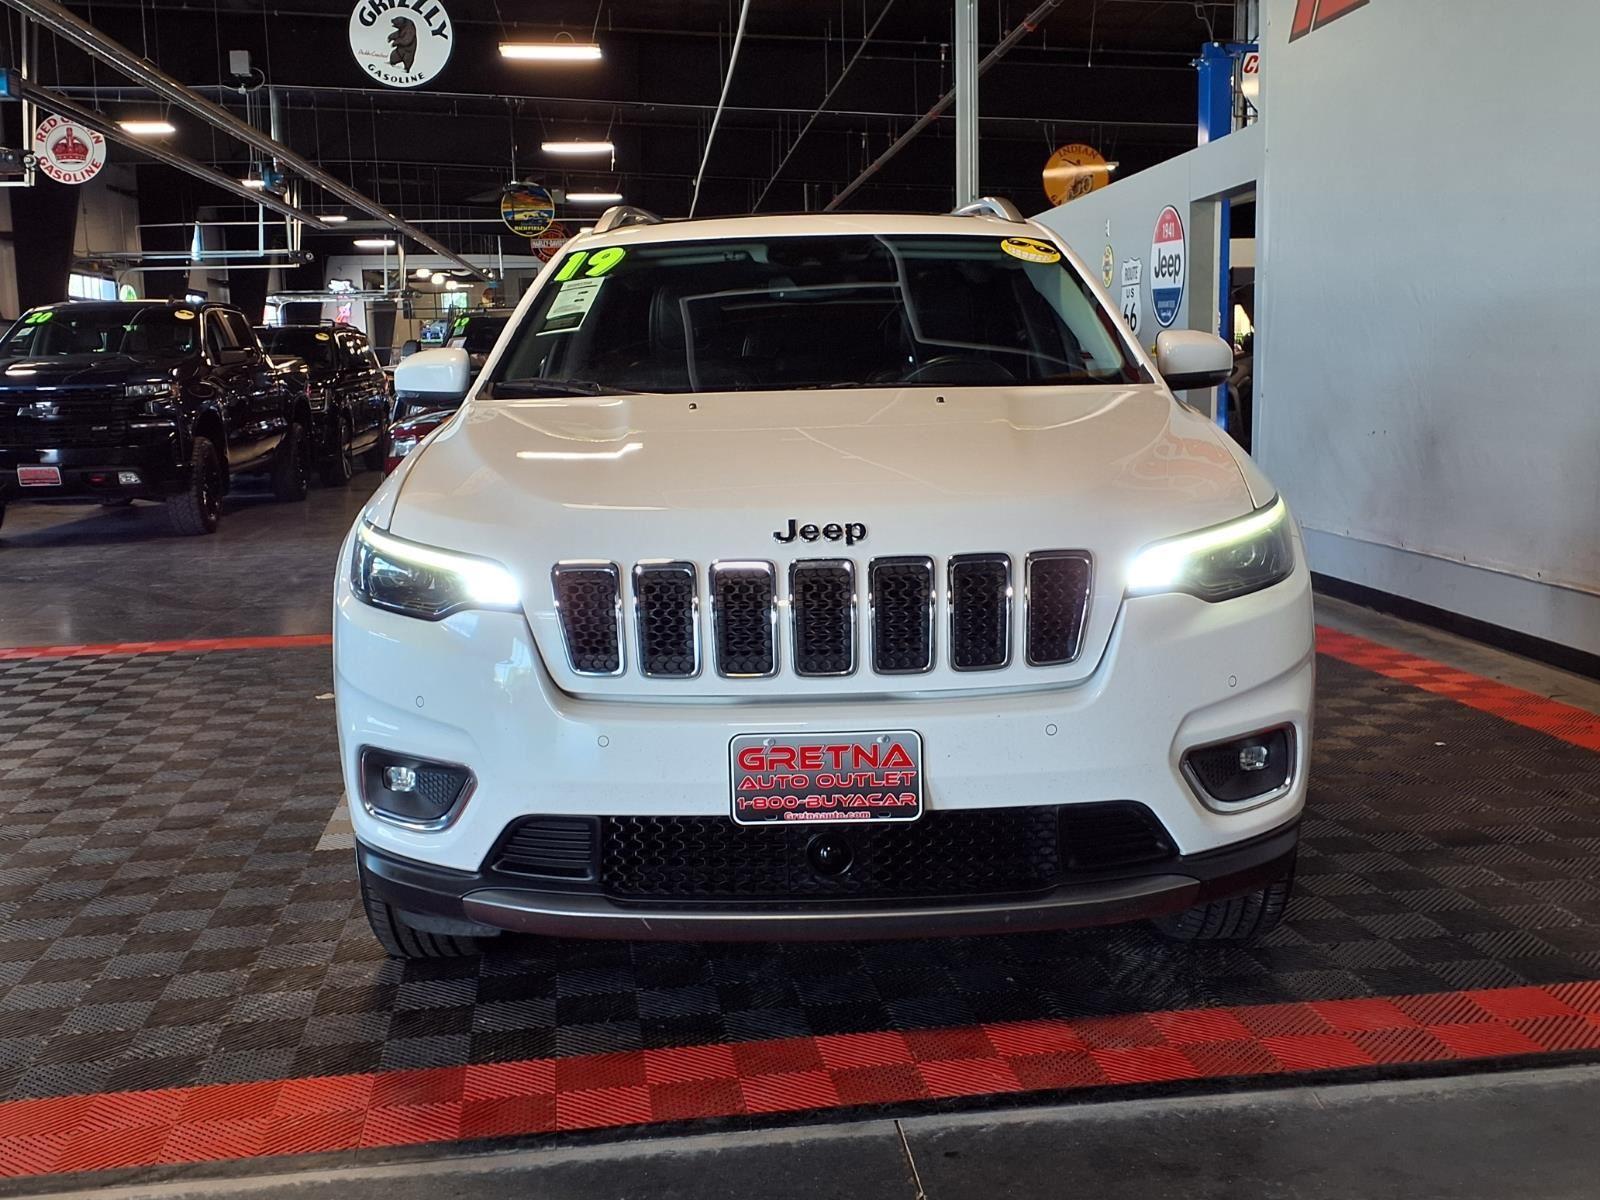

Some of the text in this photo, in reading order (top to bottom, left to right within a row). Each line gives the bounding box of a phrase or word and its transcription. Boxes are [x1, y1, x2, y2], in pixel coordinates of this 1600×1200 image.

[367, 63, 425, 84] GASOLINE
[36, 117, 58, 143] RED
[39, 156, 102, 183] GASOLINE
[554, 247, 626, 282] 19
[1154, 247, 1181, 285] Jeep
[1125, 287, 1135, 299] US
[24, 311, 54, 324] 20
[773, 519, 867, 547] Jeep
[737, 743, 915, 772] GRETNA
[737, 770, 917, 791] AUTO OUTLET
[737, 792, 917, 810] 1-800-BUYACAR
[783, 811, 871, 821] Gretnaauto.com
